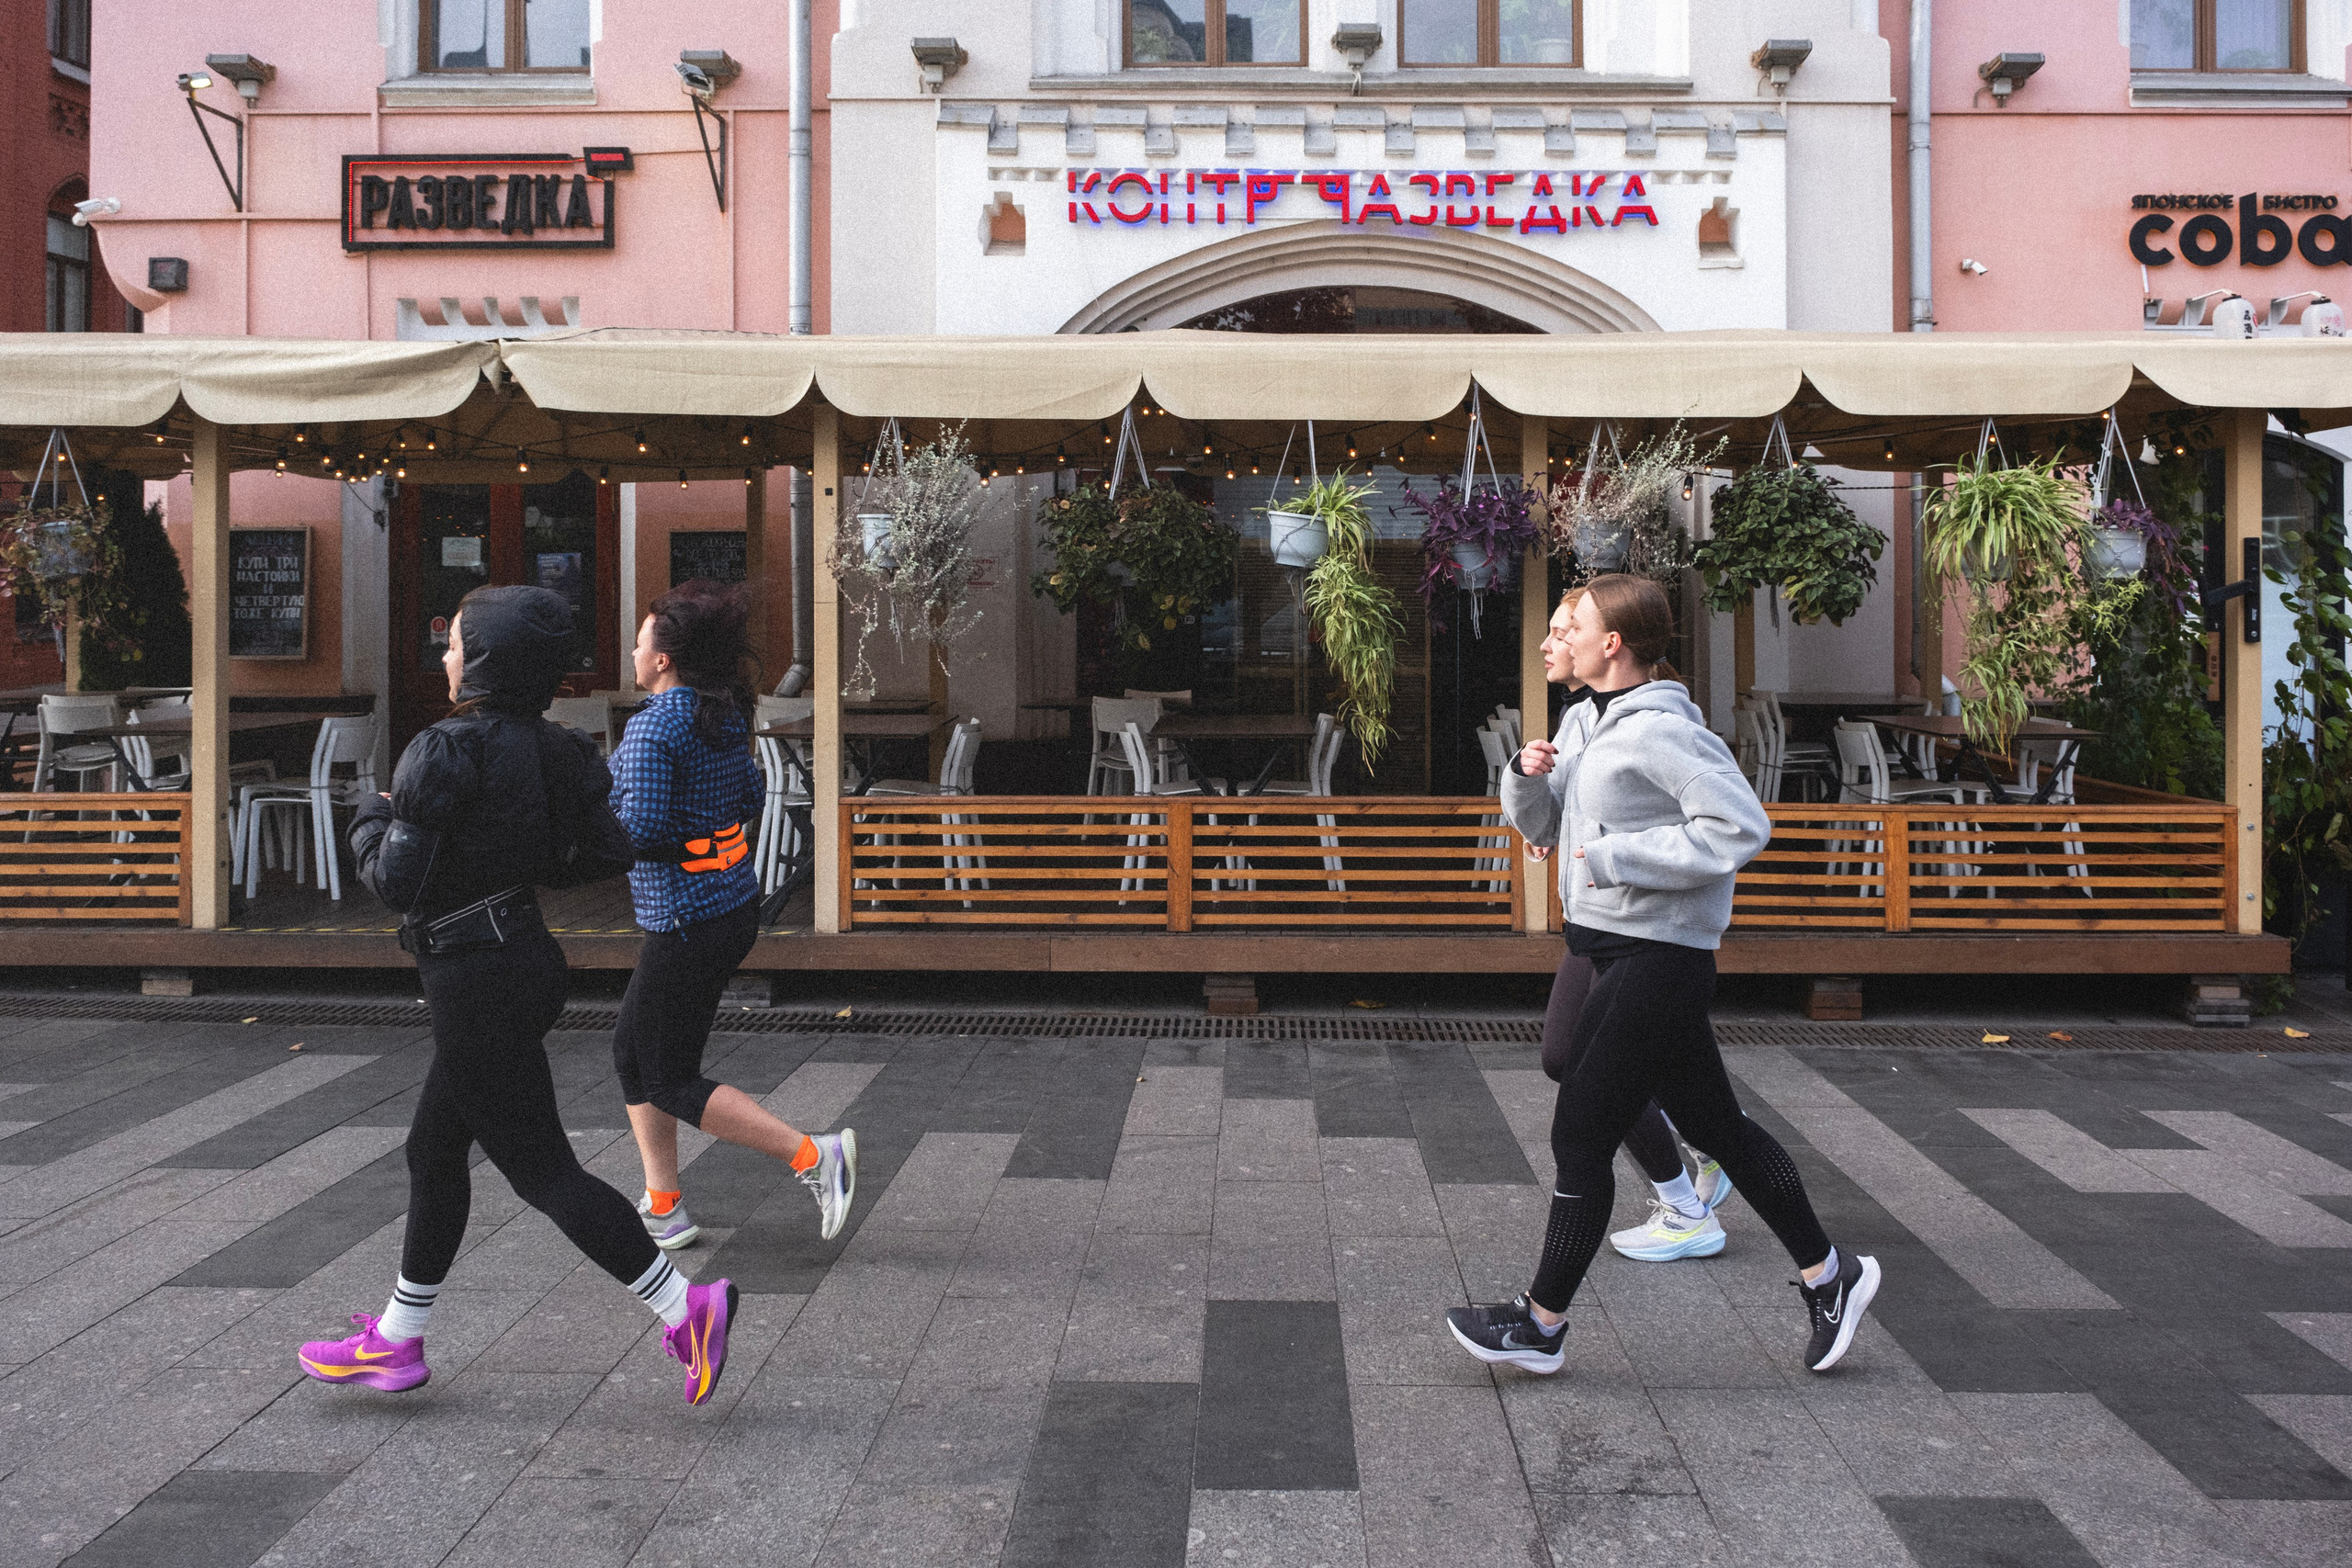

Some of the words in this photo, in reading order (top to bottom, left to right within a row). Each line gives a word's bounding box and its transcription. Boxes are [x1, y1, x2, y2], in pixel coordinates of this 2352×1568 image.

[360, 174, 594, 235] РАЗВЕДКА
[2131, 194, 2234, 209] ЯПОНСКОЕ
[2262, 195, 2338, 210] БИСТРО
[238, 557, 269, 569] КУПИ
[277, 557, 298, 569] ТРИ
